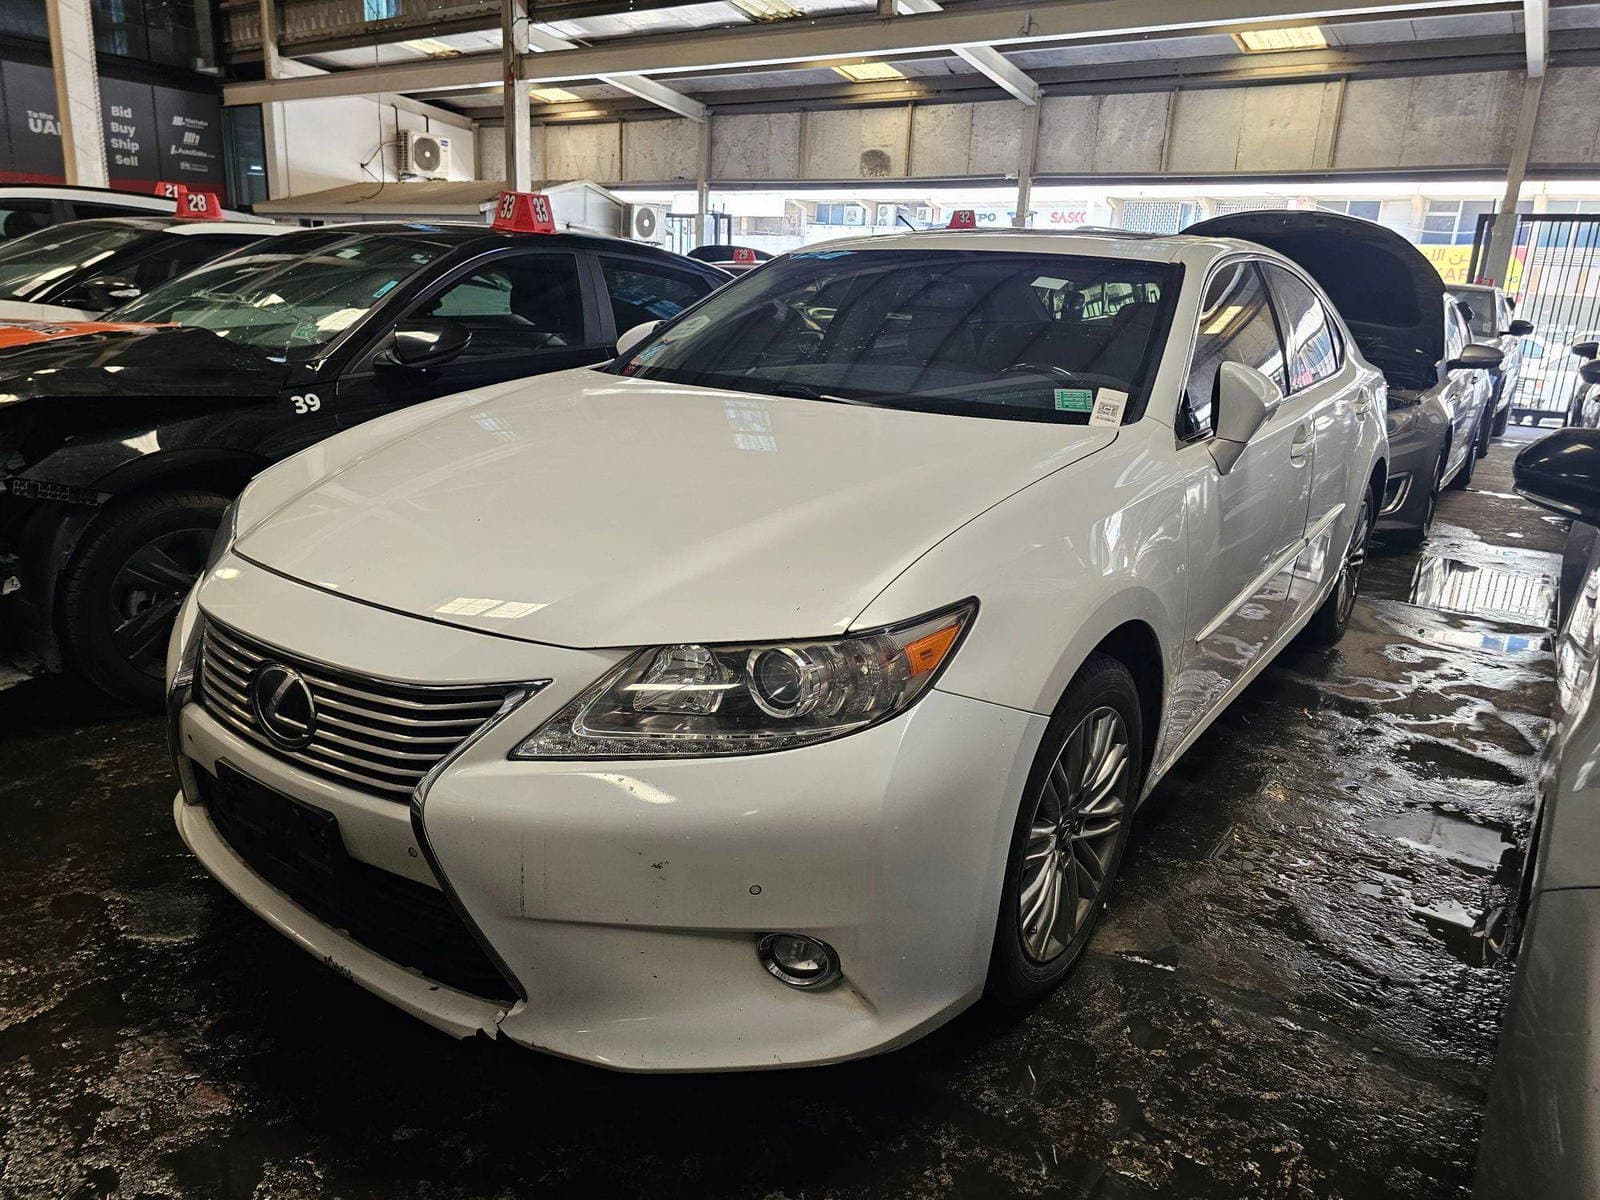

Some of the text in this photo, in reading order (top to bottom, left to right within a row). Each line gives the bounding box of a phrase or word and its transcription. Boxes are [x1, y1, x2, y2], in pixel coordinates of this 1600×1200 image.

[110, 105, 132, 119] Bid
[110, 121, 136, 138] Buy
[110, 138, 140, 153] Ship
[115, 154, 139, 167] Sell
[165, 184, 179, 198] 21
[188, 194, 208, 212] 28
[501, 194, 516, 219] 33
[533, 197, 549, 223] 33
[959, 211, 971, 223] 32
[290, 393, 321, 414] 39
